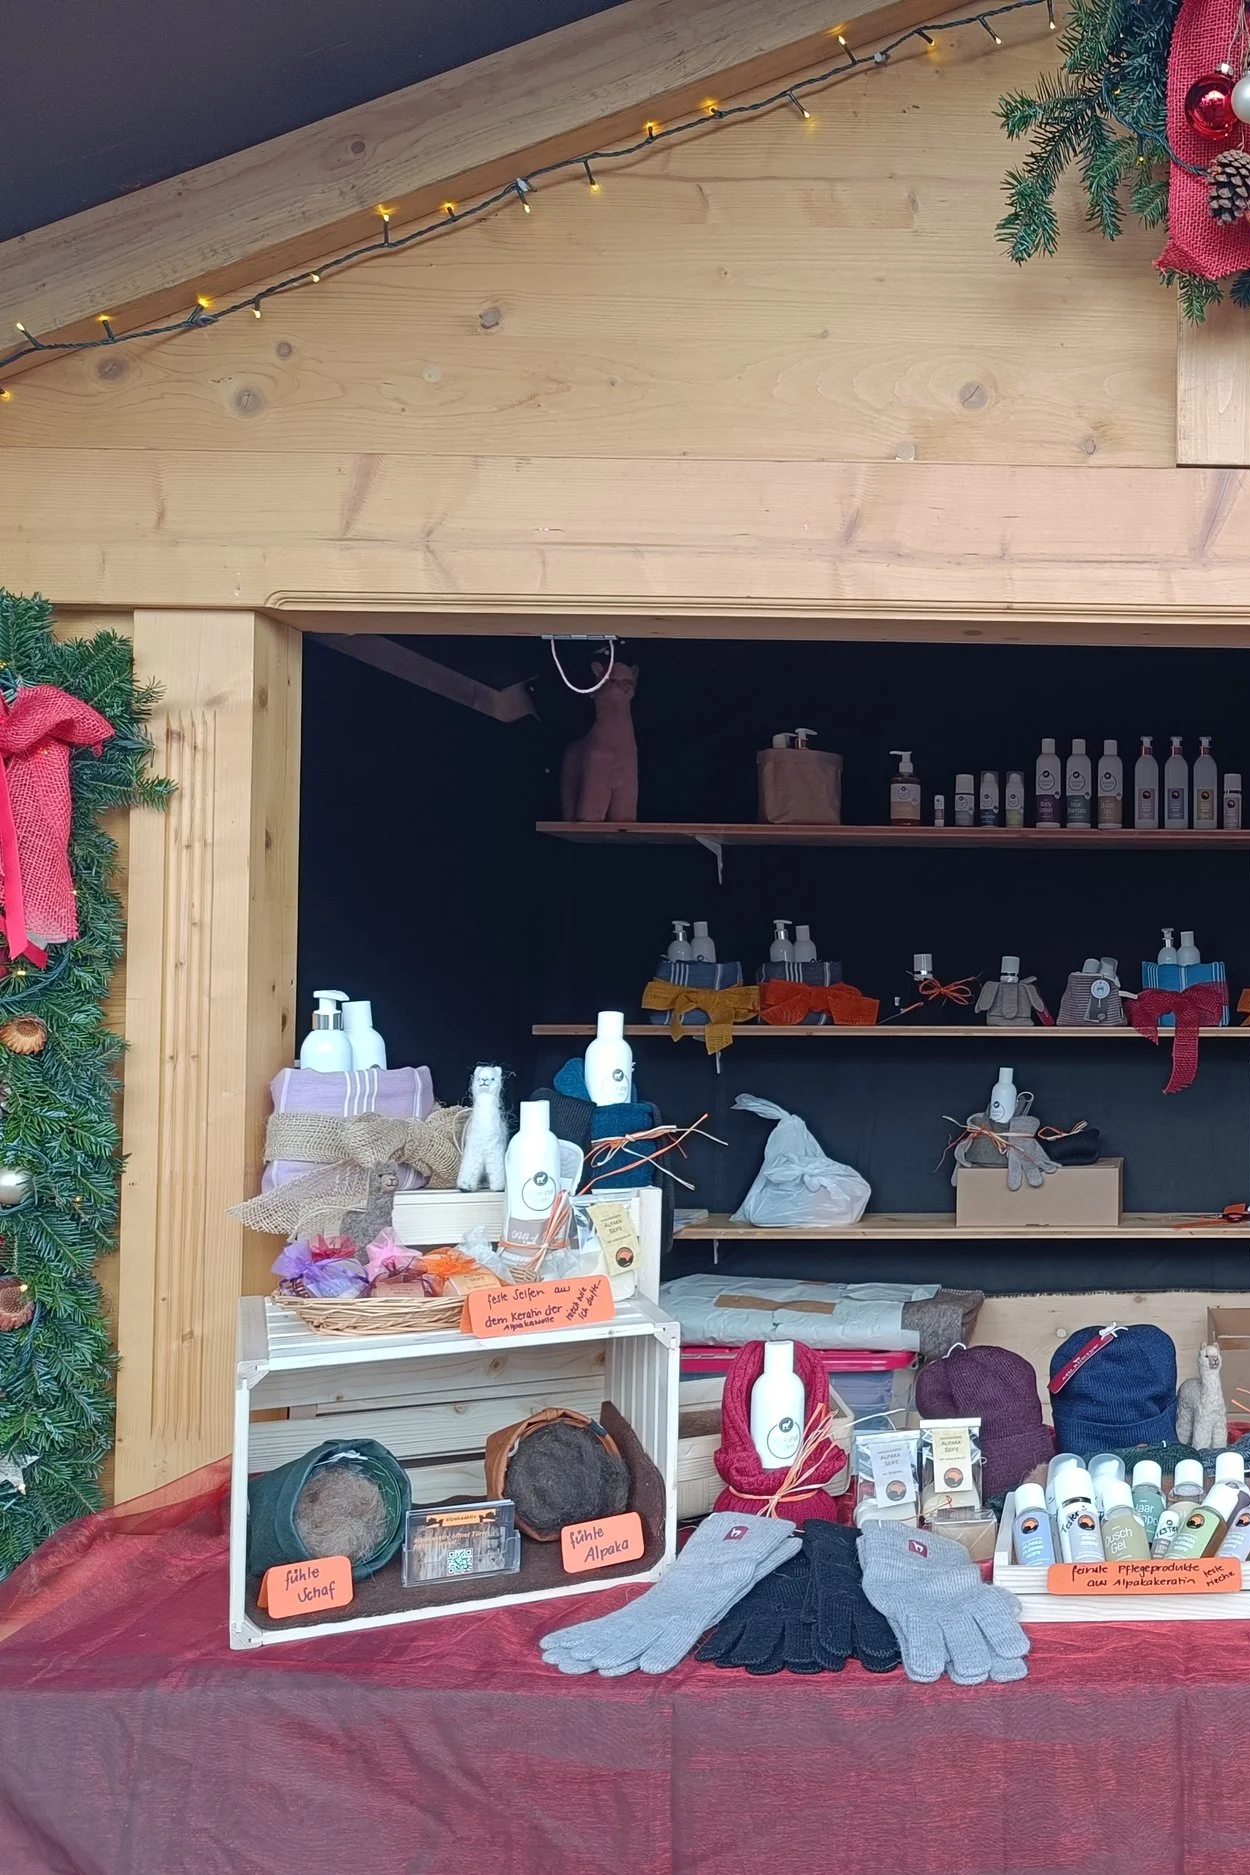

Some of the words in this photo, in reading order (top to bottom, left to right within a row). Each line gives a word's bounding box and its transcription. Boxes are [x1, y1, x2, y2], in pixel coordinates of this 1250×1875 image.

[487, 1292, 508, 1310] feste
[485, 1315, 508, 1328] dem
[511, 1307, 542, 1322] Keratin
[544, 1304, 563, 1316] der
[941, 1439, 962, 1447] ALPAKA
[880, 1451, 901, 1460] ALPAKA
[883, 1459, 900, 1468] SEIFE
[1060, 1510, 1080, 1534] Tester
[570, 1526, 605, 1550] fühle
[1105, 1527, 1134, 1547] Dusch
[1111, 1539, 1127, 1554] Gel
[583, 1539, 630, 1563] Alpaka
[285, 1567, 320, 1592] fühle
[1118, 1563, 1200, 1578] Pflegeprodukte
[297, 1580, 336, 1603] Schaf
[1112, 1576, 1196, 1589] Alpakakeratin
